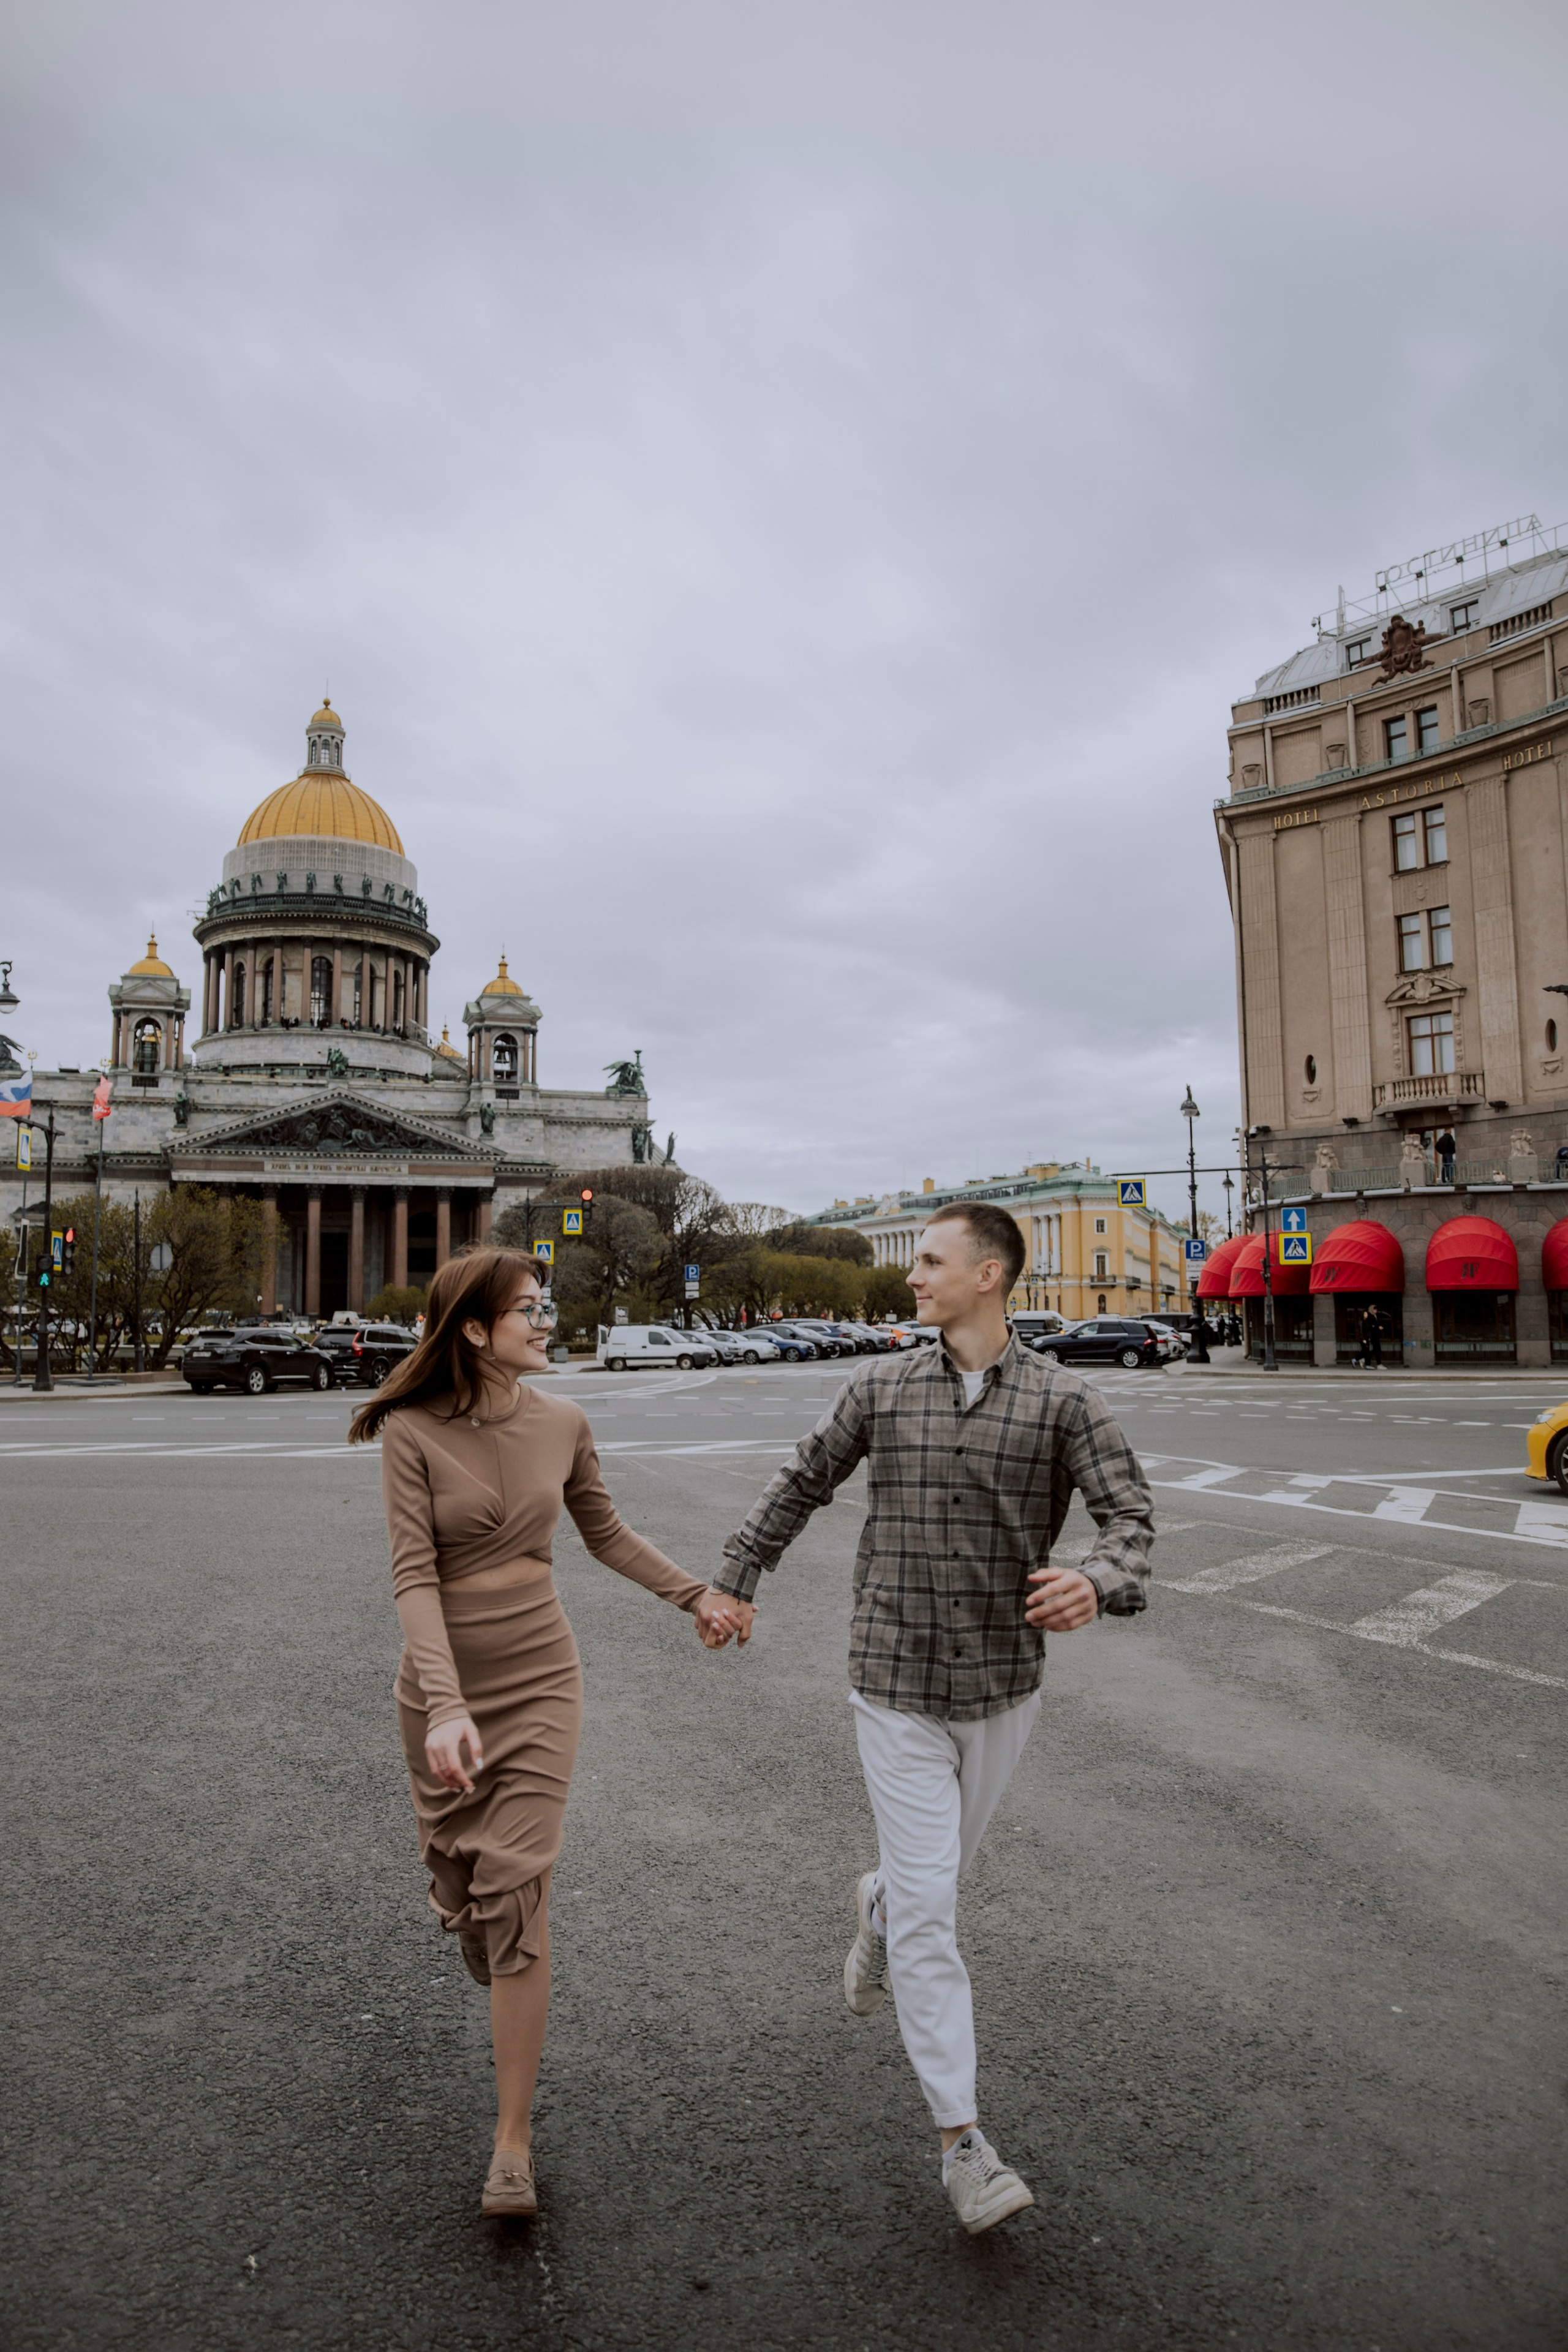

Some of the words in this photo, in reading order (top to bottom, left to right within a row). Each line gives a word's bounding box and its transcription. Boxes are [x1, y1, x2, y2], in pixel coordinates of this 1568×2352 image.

[1376, 513, 1542, 589] ГОСТИНИЦА
[1504, 741, 1553, 770] HOTEL
[1362, 772, 1463, 809] ASTORIA
[1274, 809, 1319, 829] HOTEL
[1190, 1242, 1202, 1257] P
